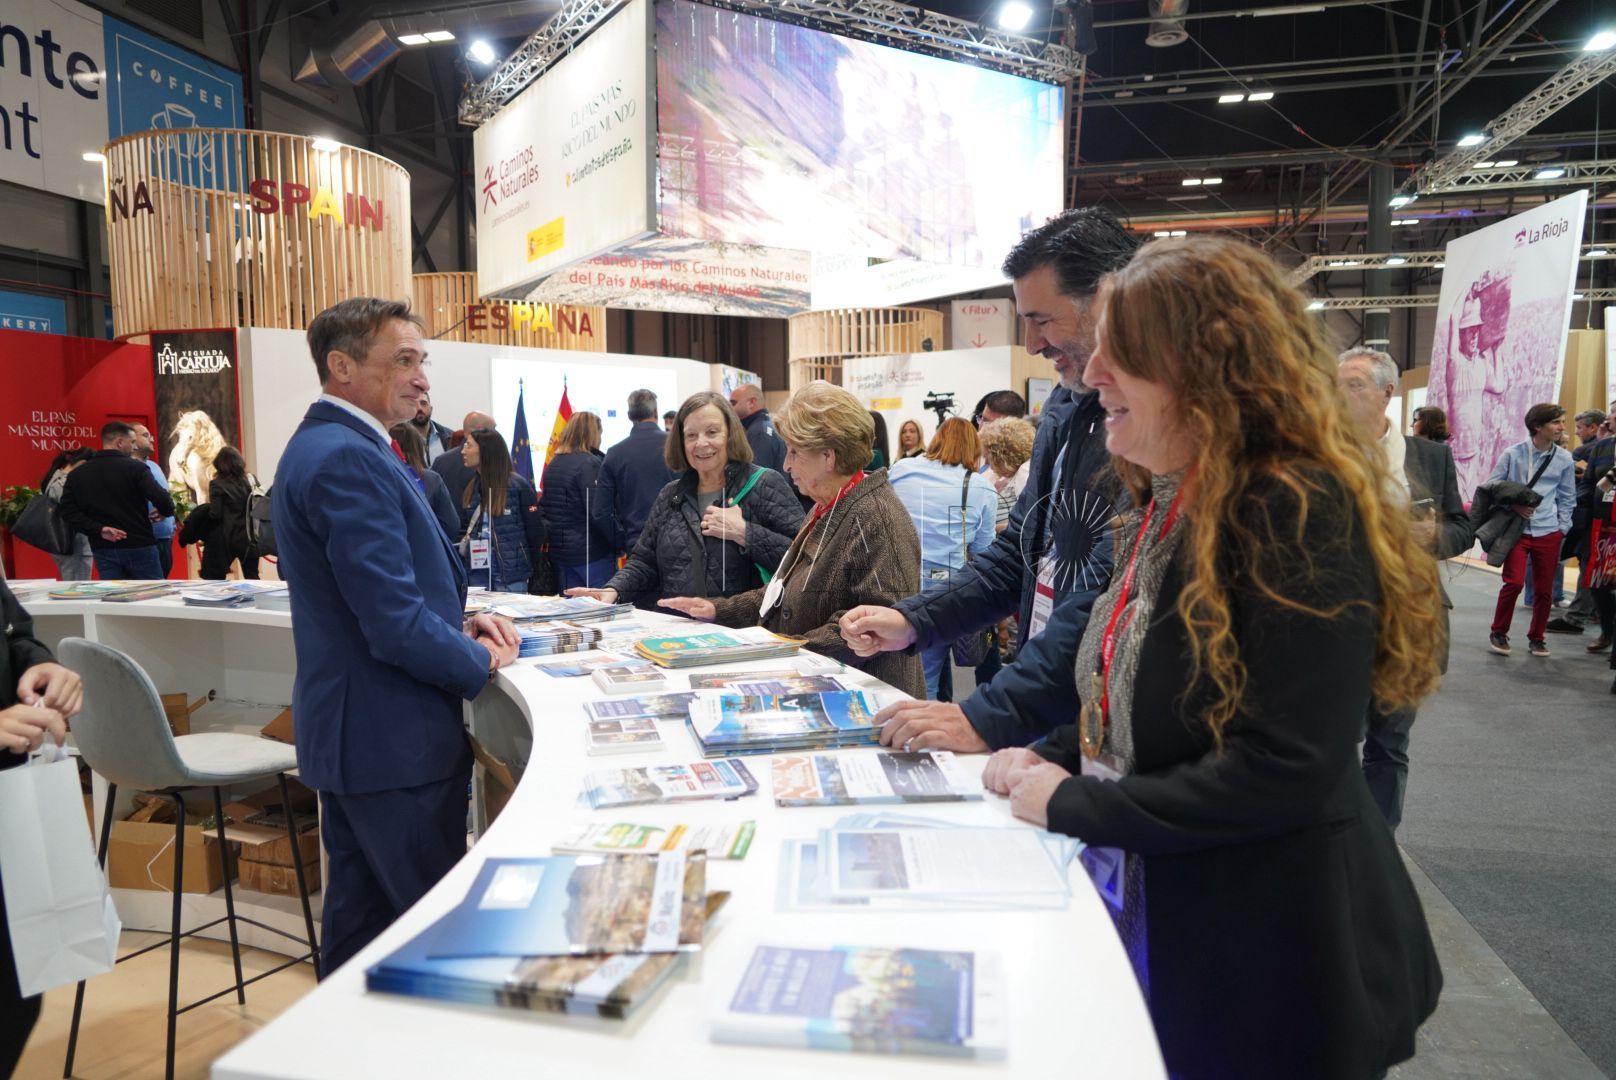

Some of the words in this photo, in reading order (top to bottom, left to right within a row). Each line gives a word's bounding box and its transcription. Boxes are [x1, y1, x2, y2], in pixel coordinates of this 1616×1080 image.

[132, 61, 223, 110] COFFEE
[500, 144, 534, 180] Caminos
[500, 164, 540, 201] Naturales
[250, 178, 384, 232] SPAIN
[1528, 229, 1540, 245] La
[1541, 217, 1569, 240] Rioja
[569, 271, 592, 285] del
[641, 258, 664, 273] por
[669, 259, 688, 273] los
[692, 261, 747, 278] Caminos
[751, 267, 809, 283] Naturales
[468, 304, 594, 337] ESPAÑA
[178, 355, 232, 369] CARTUJA
[32, 410, 48, 423] EL
[8, 424, 39, 438] MÁS
[40, 425, 72, 438] RICO
[74, 426, 97, 438] DEL
[31, 439, 81, 451] MUNDO
